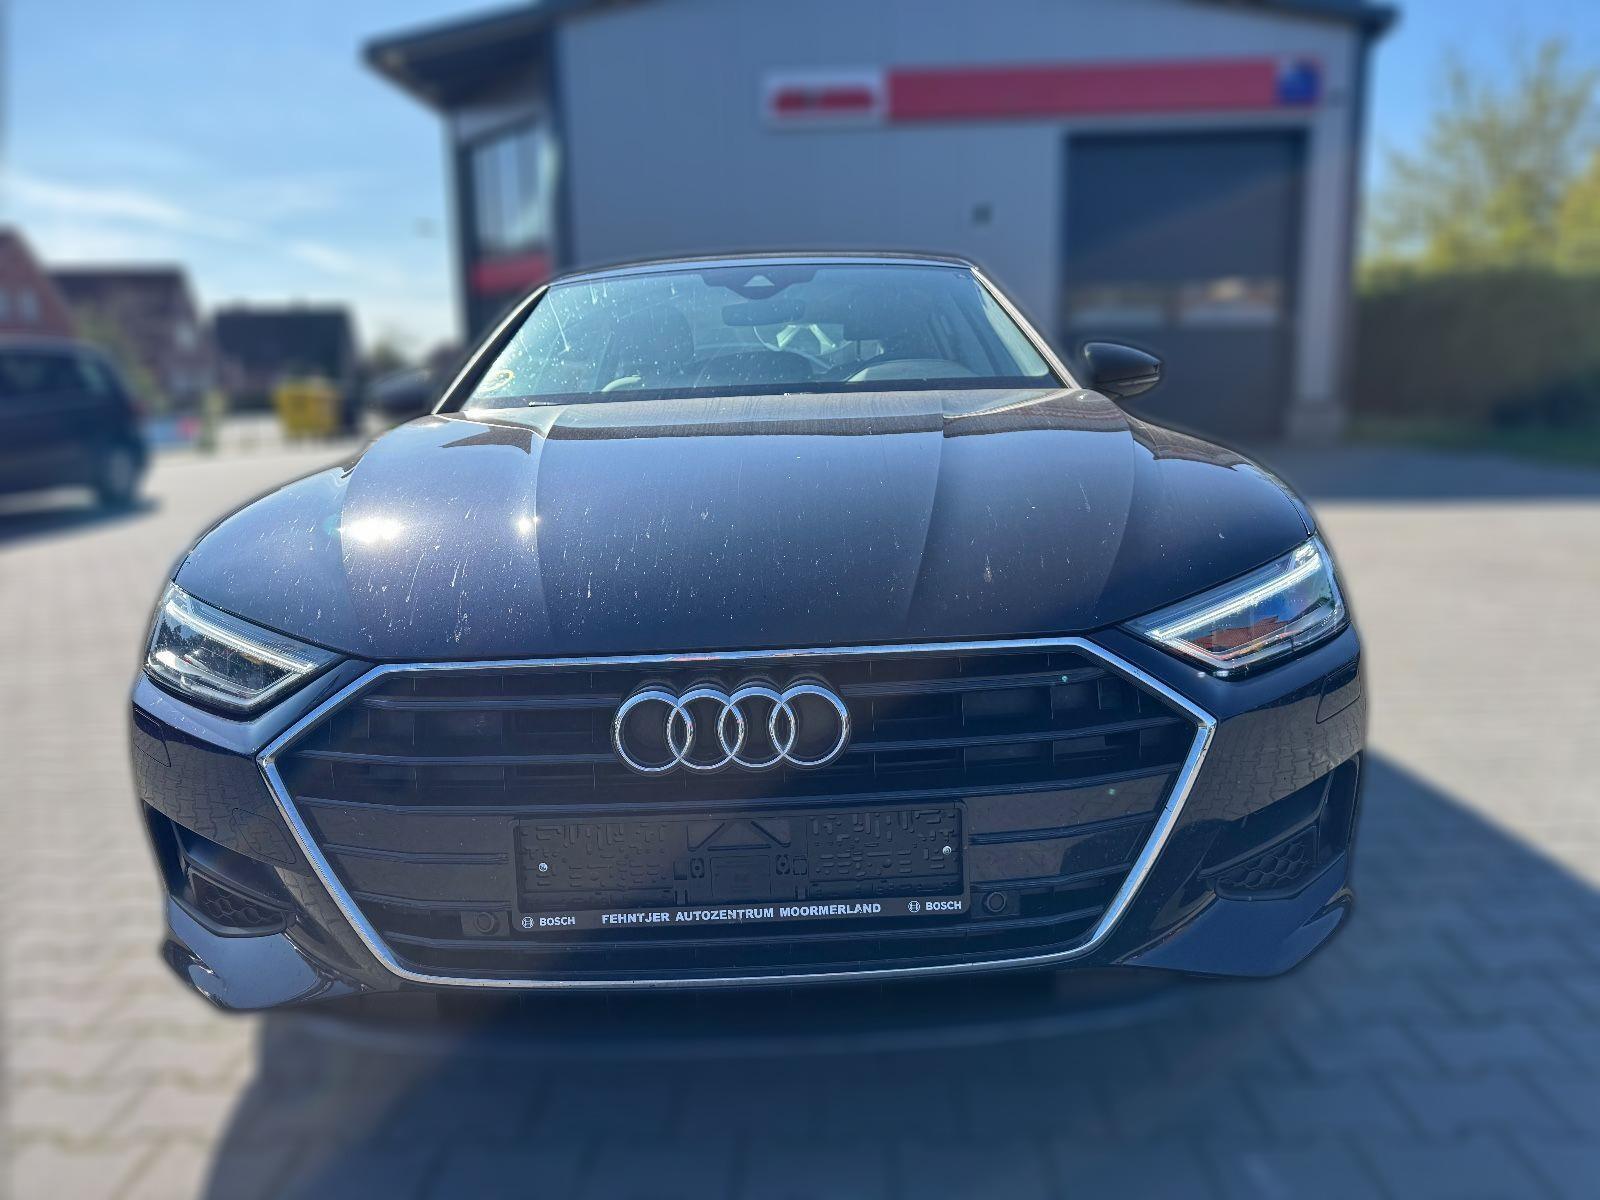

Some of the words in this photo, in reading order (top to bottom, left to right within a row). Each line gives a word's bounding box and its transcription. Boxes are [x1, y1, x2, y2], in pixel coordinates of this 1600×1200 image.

[925, 900, 962, 911] BOSCH
[539, 914, 576, 927] BOSCH
[601, 912, 671, 925] FEHNTJER
[675, 907, 774, 922] AUTOZENTRUM
[779, 903, 882, 918] MOORMERLAND
